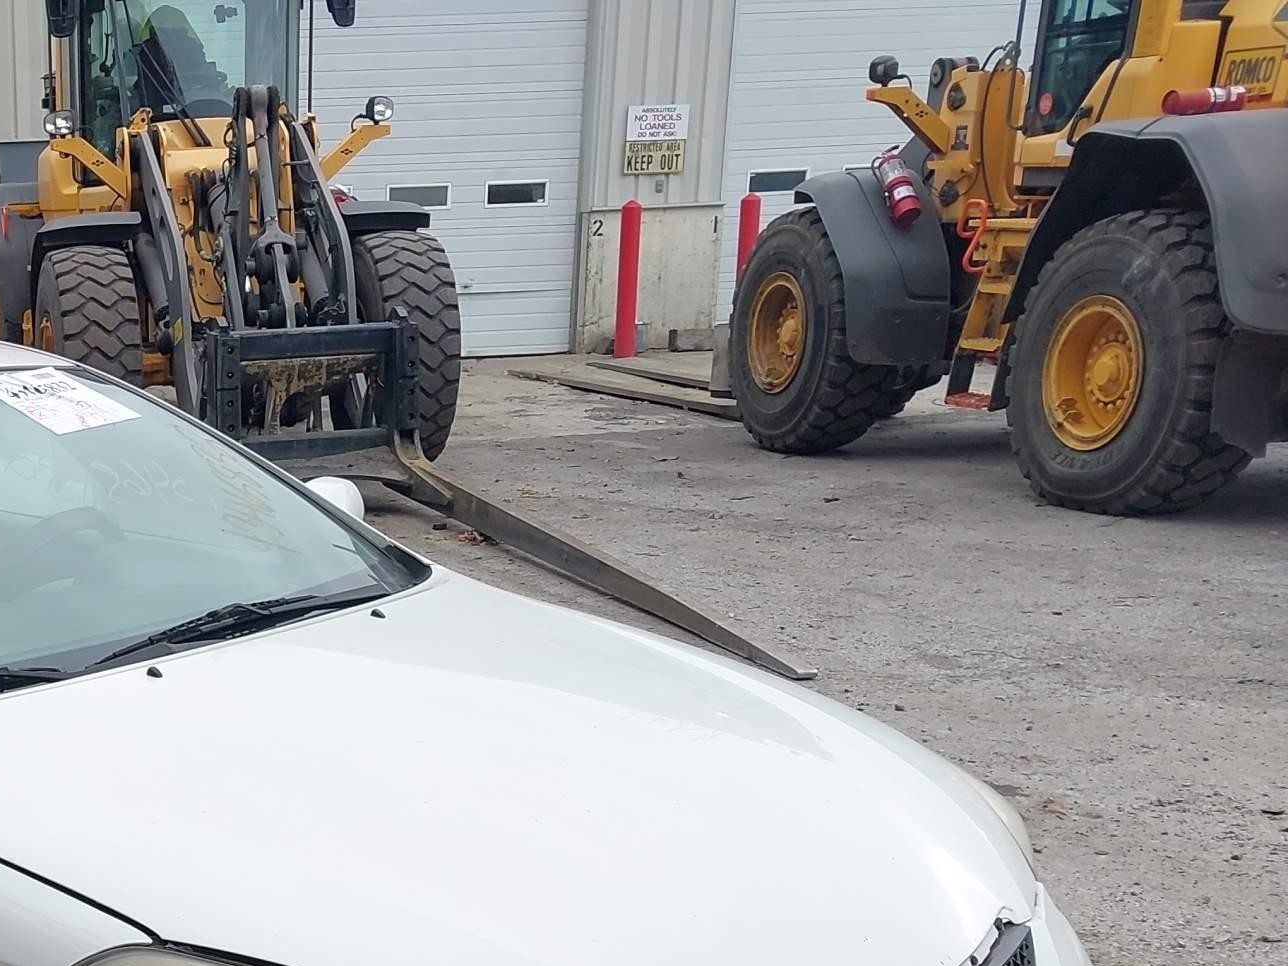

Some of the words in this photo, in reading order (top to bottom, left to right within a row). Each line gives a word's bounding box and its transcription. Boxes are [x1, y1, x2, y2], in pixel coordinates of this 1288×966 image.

[1225, 56, 1276, 86] ROMCO
[634, 114, 649, 122] NO
[652, 113, 682, 121] TOOLS
[639, 122, 676, 130] LOANED
[629, 142, 663, 153] RESTRICTED
[666, 142, 681, 151] AREA
[626, 154, 653, 172] KEEP
[660, 154, 681, 170] OUT
[592, 219, 604, 237] 2
